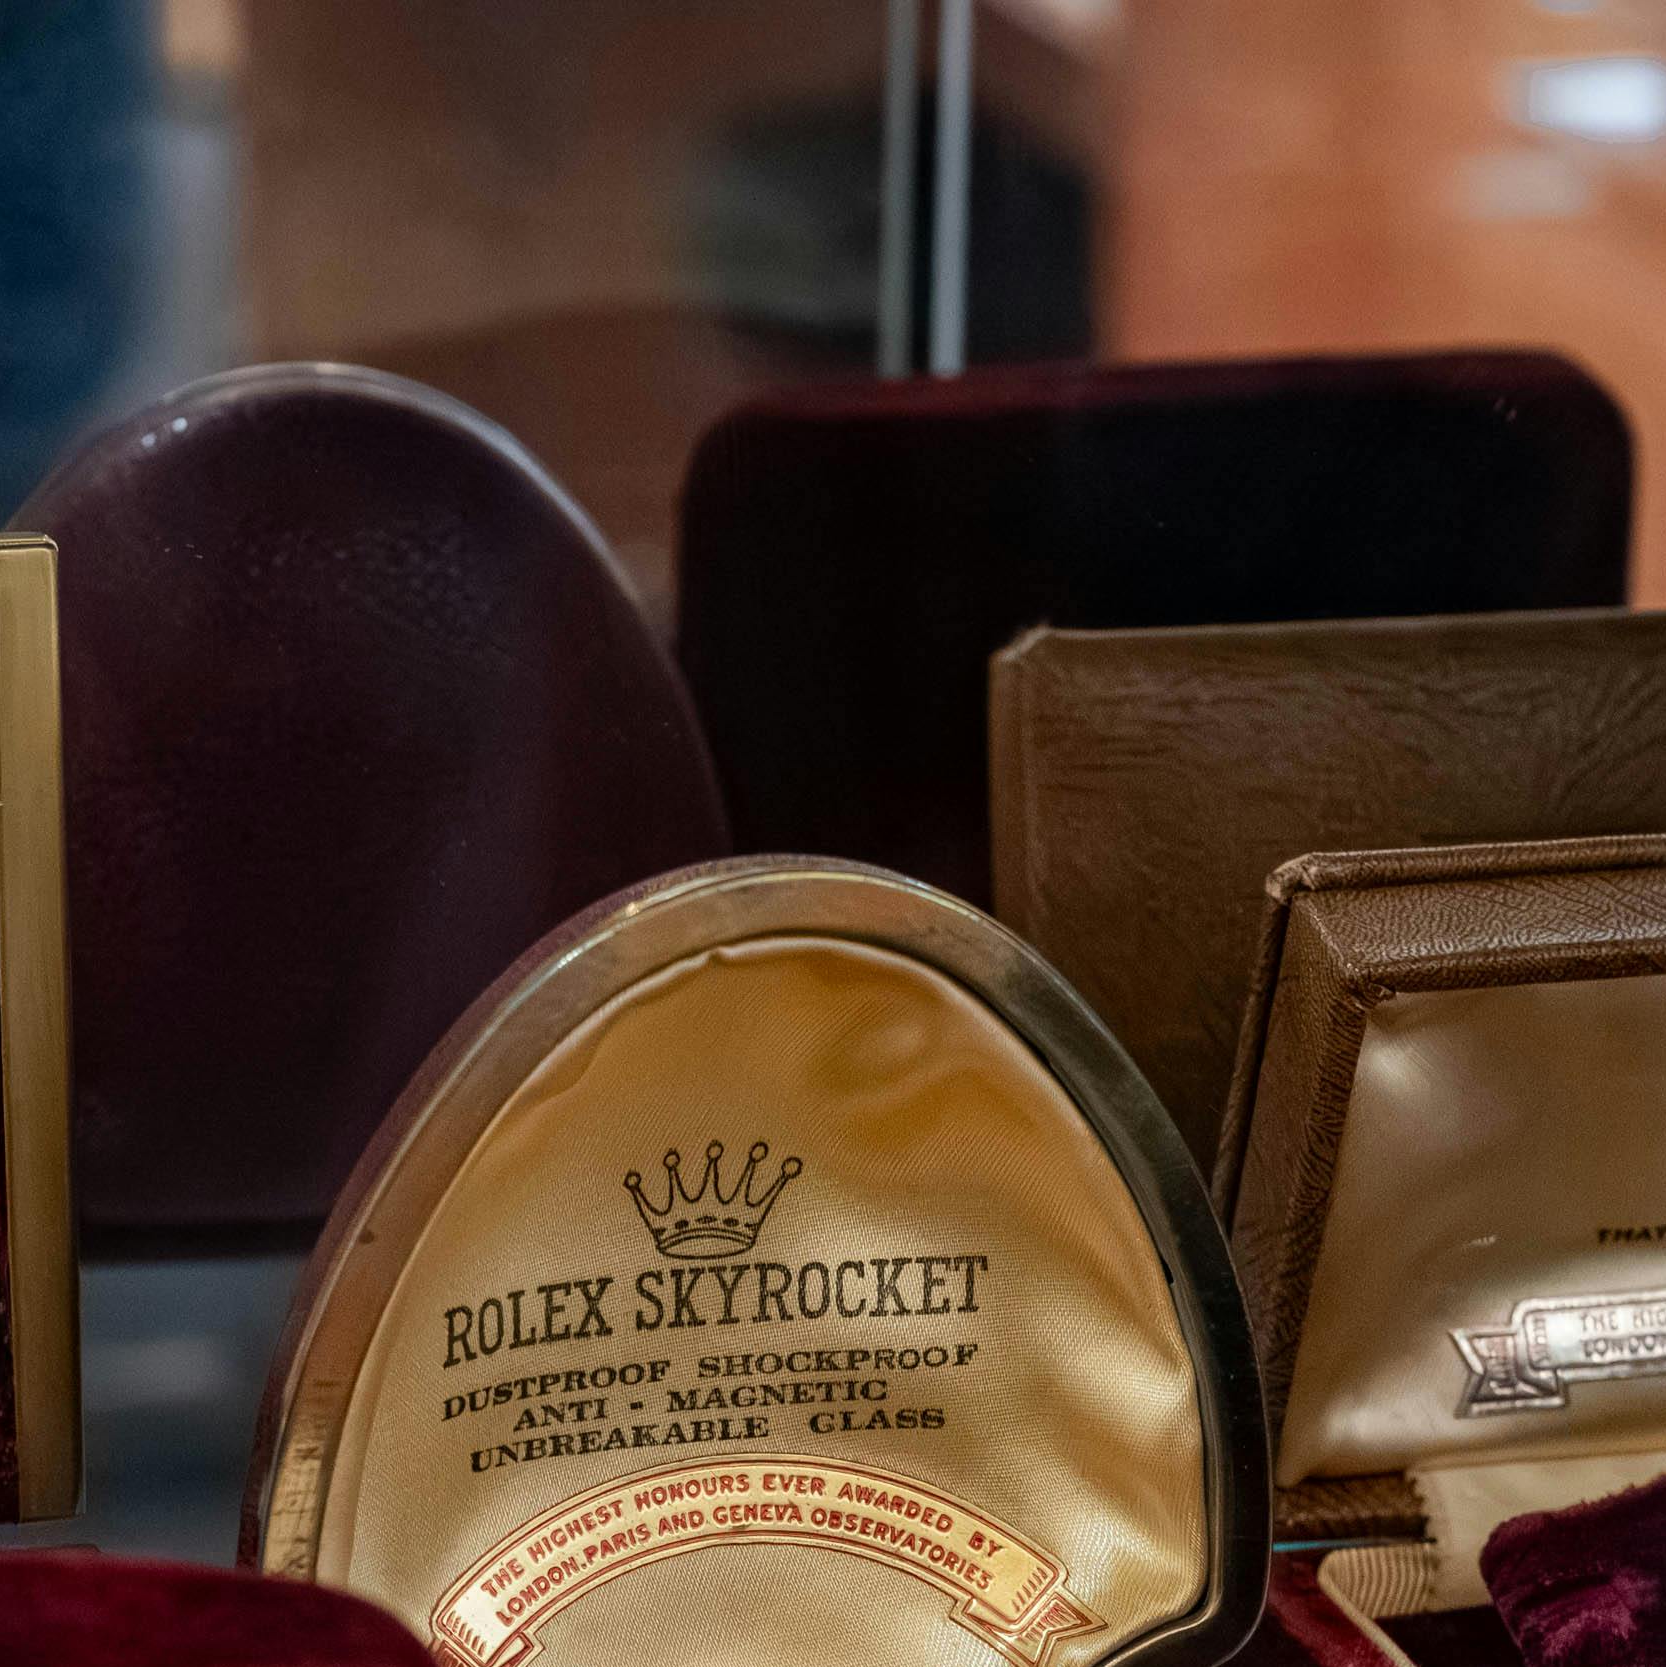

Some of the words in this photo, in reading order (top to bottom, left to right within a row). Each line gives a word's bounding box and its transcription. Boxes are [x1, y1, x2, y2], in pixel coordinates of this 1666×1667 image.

[443, 1277, 614, 1370] ROLEX
[635, 1255, 988, 1331] SKYROCKET
[1581, 1312, 1619, 1332] THE
[441, 1360, 670, 1421] DUSTPROOF
[698, 1344, 979, 1378] SHOCKPROOF
[513, 1398, 608, 1432] ANTI
[667, 1379, 888, 1413] MAGNETIC
[470, 1416, 769, 1473] UNBREAKABLE
[809, 1407, 946, 1434] GLASS
[481, 1557, 525, 1598] THE
[531, 1500, 623, 1564] HIGHEST
[634, 1474, 751, 1511] HONOURS
[762, 1473, 825, 1496] EVER
[838, 1482, 954, 1534] AWARDED
[967, 1531, 1003, 1558] BY
[657, 1509, 705, 1537] AND
[712, 1503, 803, 1526] GENEVA
[810, 1507, 994, 1591] OBSERVATORIES
